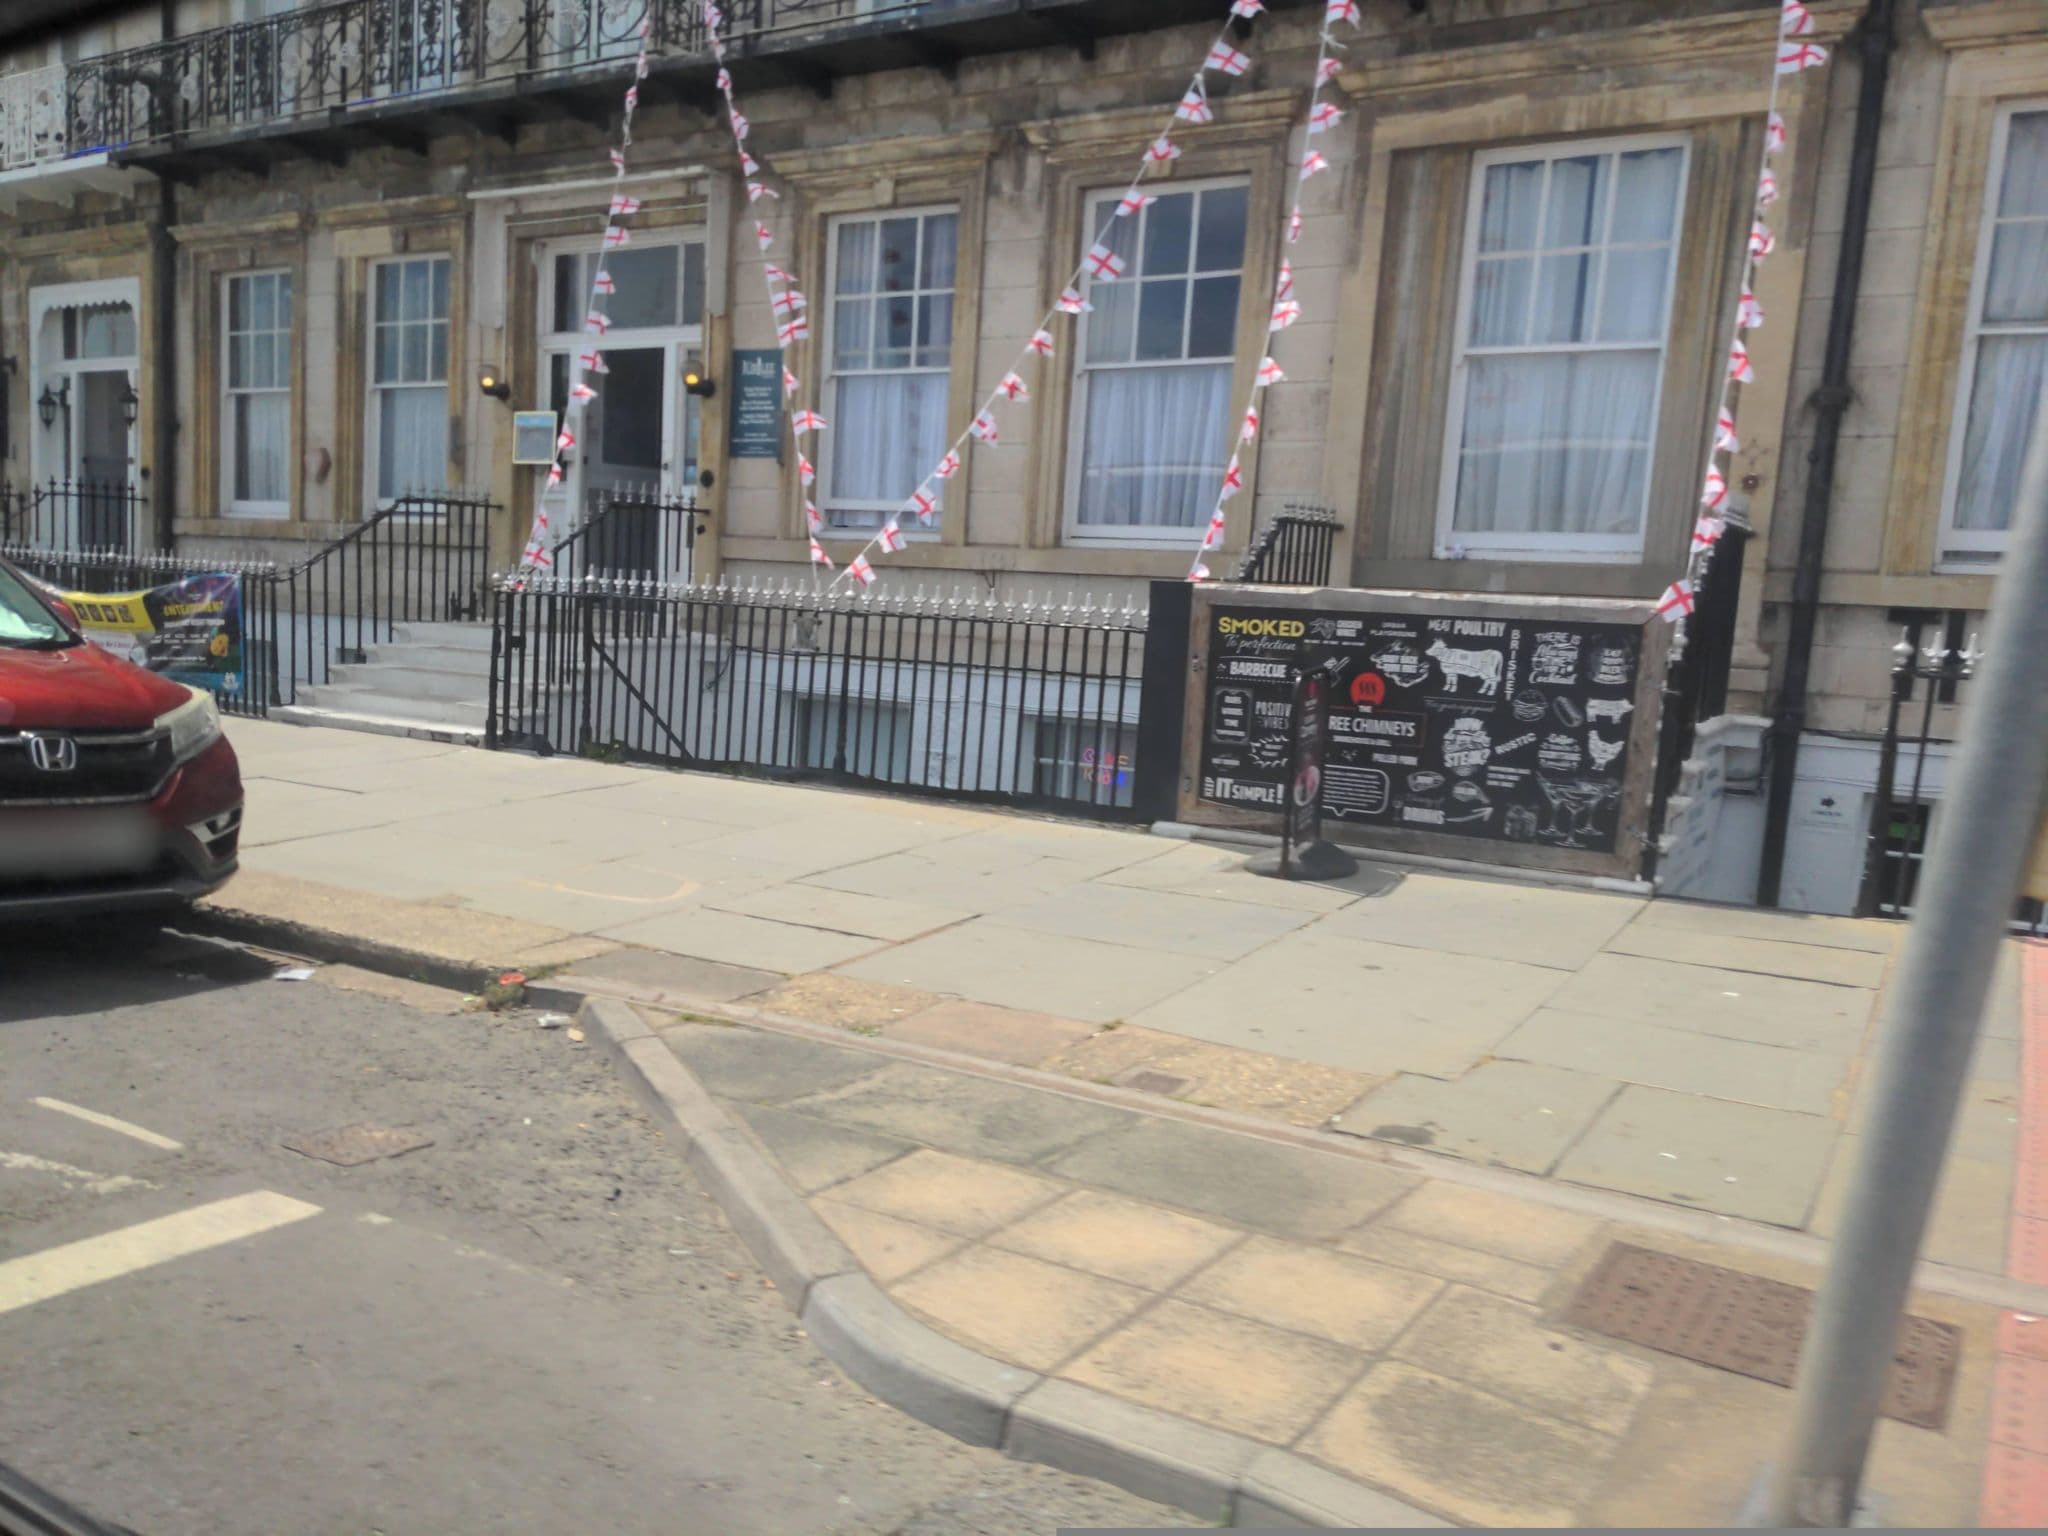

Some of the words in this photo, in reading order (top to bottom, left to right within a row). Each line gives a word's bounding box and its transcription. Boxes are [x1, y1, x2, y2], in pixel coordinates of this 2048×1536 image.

[1218, 616, 1306, 638] SMOKED
[1453, 620, 1507, 638] POULTRY
[1235, 636, 1297, 655] perfection
[1229, 660, 1288, 679] BARBECUE
[1503, 628, 1521, 701] BRISKET
[1351, 717, 1417, 738] CHIMNEYS
[1214, 776, 1235, 799] IT
[1231, 783, 1285, 805] SIMPLE!
